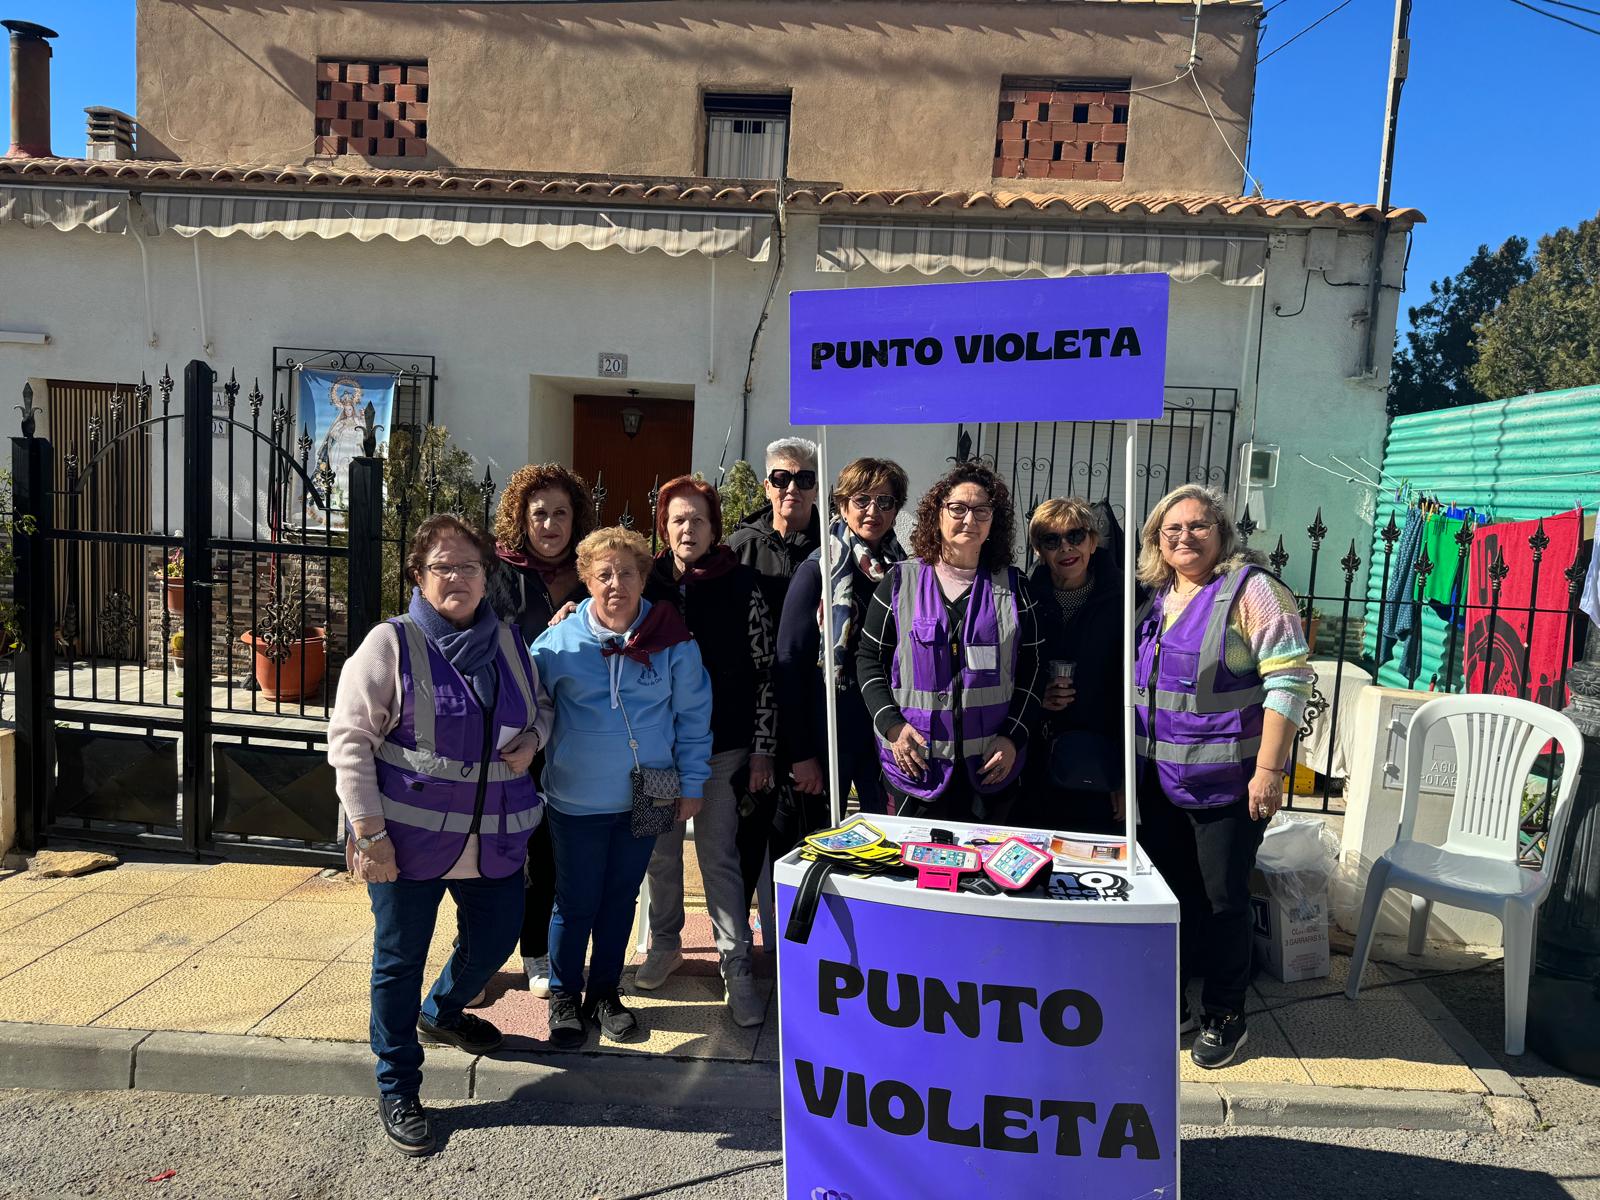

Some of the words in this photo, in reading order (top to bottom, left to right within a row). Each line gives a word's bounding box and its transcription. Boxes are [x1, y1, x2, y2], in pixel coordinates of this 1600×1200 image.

[811, 337, 943, 370] PUNTO
[954, 326, 1142, 364] VIOLETA
[606, 359, 620, 372] 20
[1421, 774, 1457, 787] OTAB
[1430, 761, 1456, 774] AGU
[818, 959, 1104, 1047] PUNTO
[794, 1058, 1161, 1161] VIOLETA
